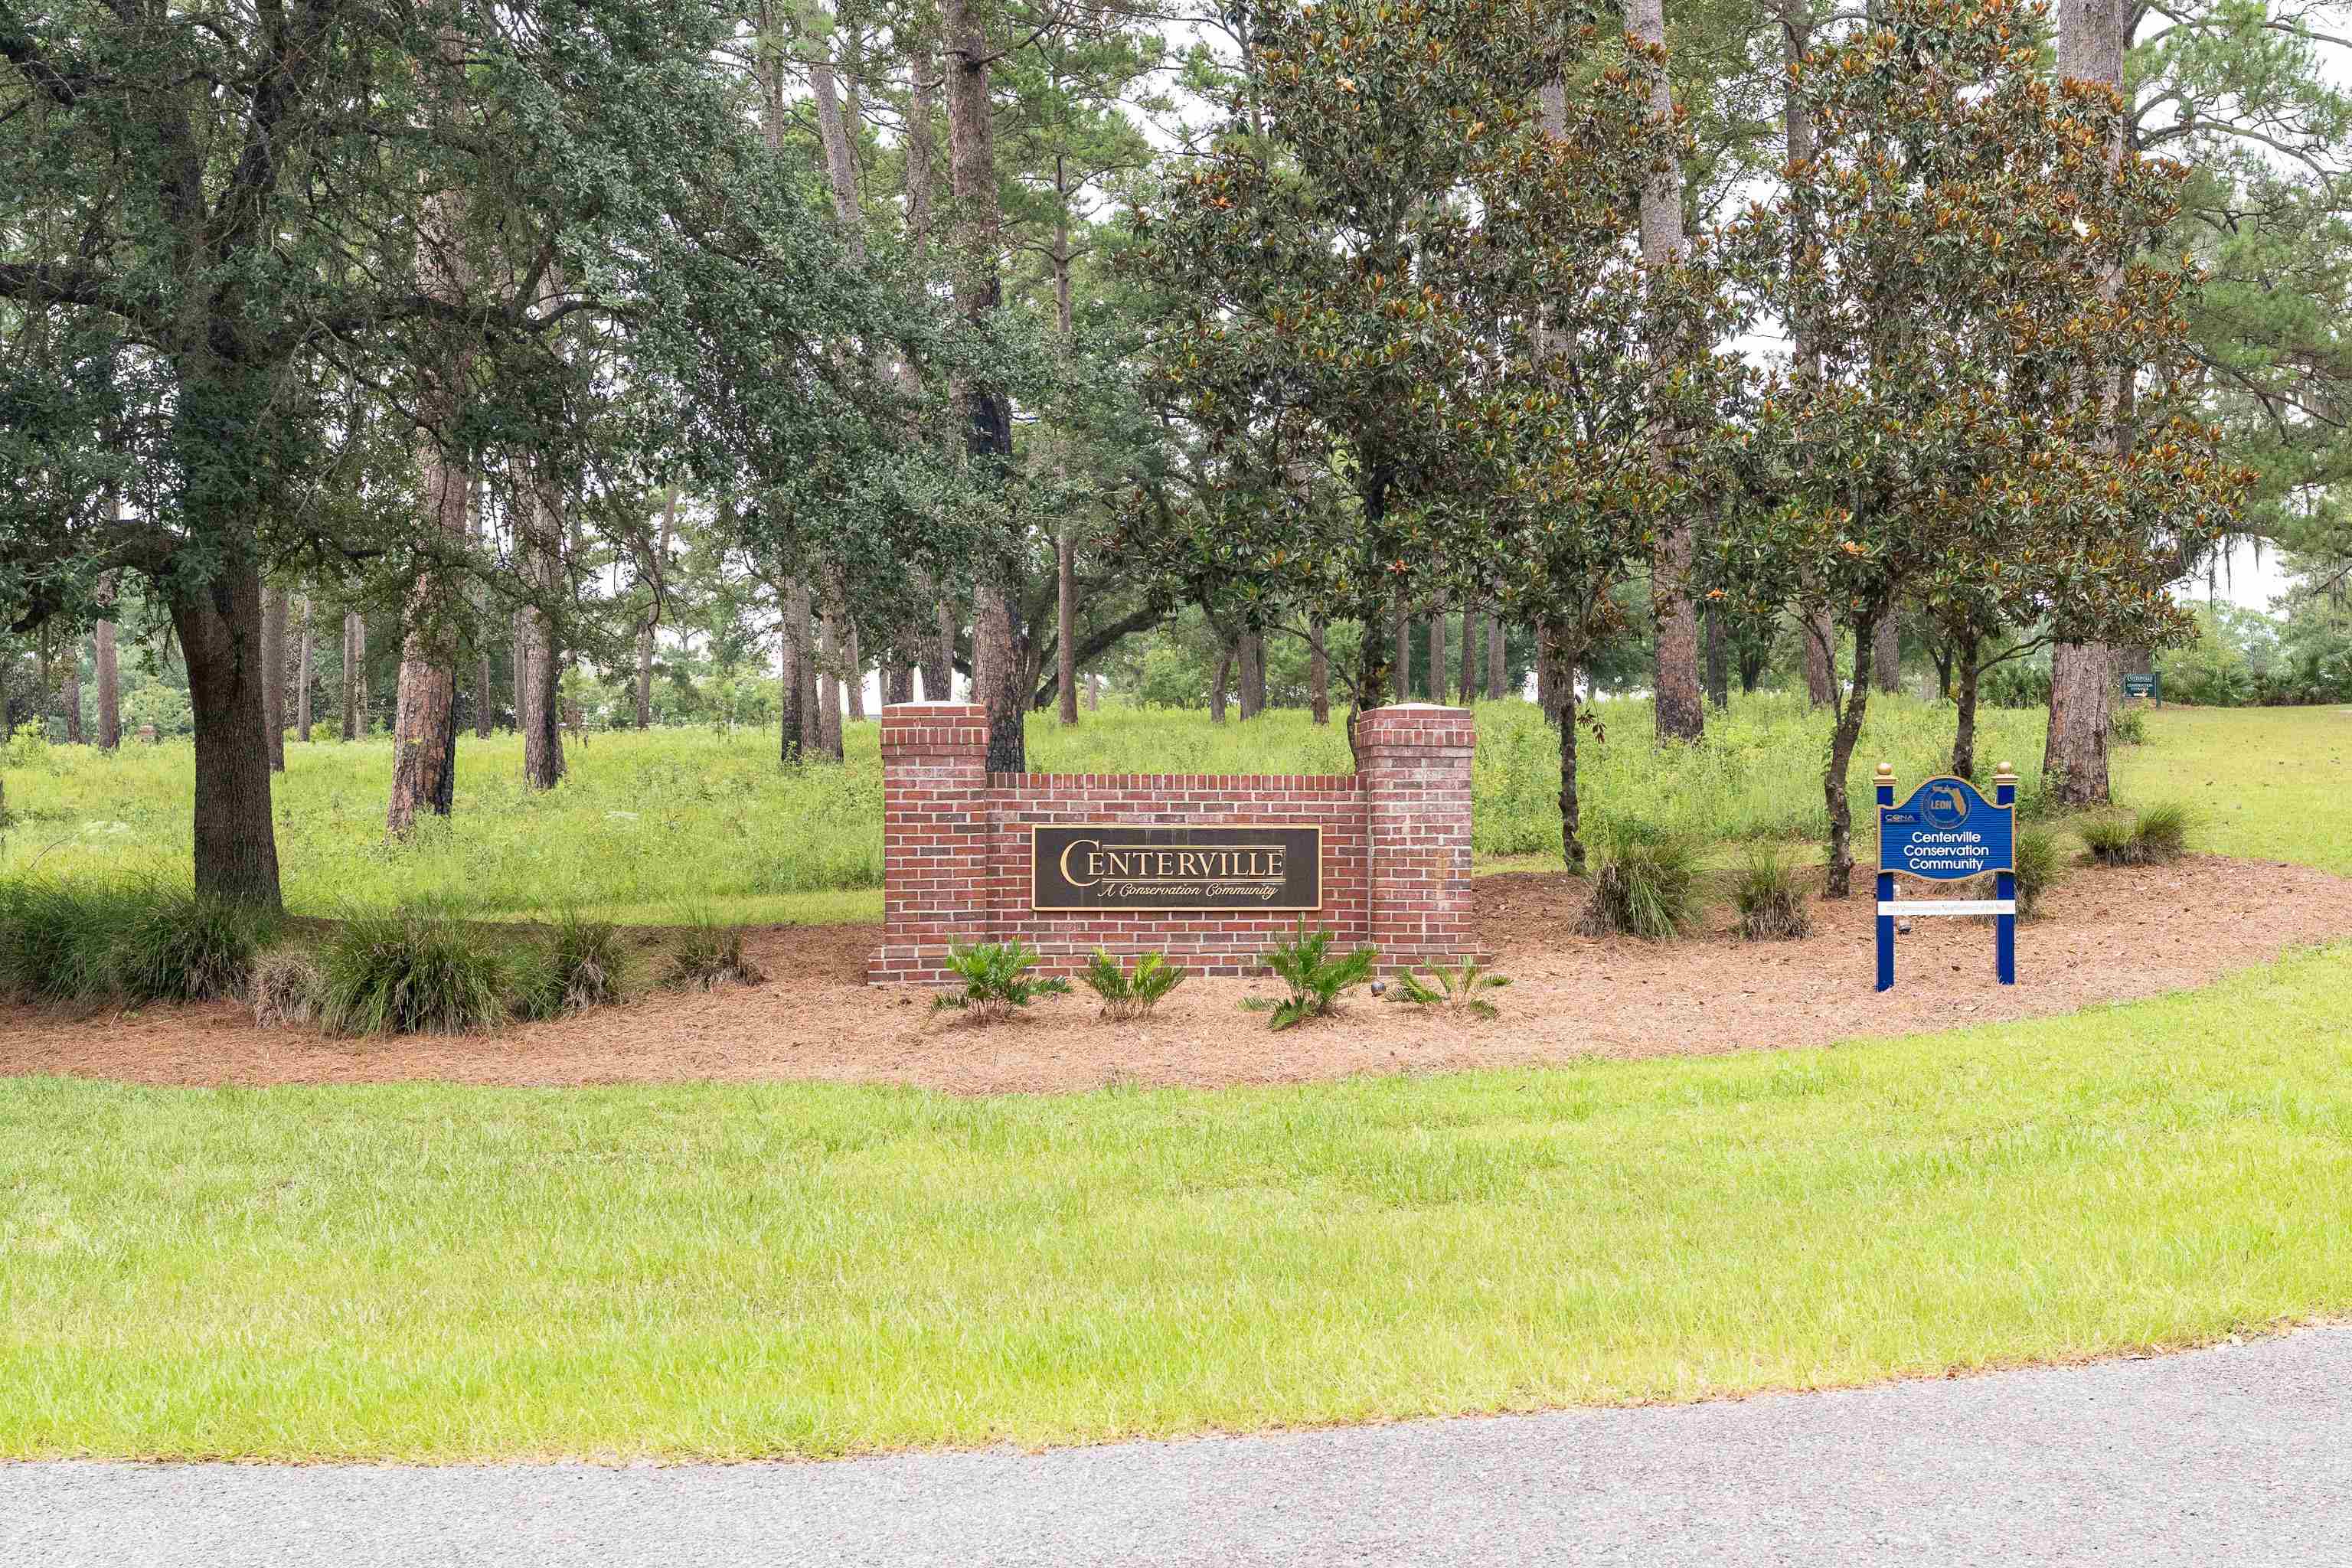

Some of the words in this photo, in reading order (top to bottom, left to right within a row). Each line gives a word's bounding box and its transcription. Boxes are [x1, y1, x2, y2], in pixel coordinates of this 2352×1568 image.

[1930, 799, 1952, 810] LEON
[1911, 831, 1981, 843] Centerville
[1903, 844, 1989, 857] Conservation
[1060, 839, 1286, 887] CENTERVILLE
[1909, 858, 1984, 871] Community
[1097, 882, 1116, 897] A
[1119, 882, 1202, 897] Conservation
[1205, 882, 1279, 900] Community
